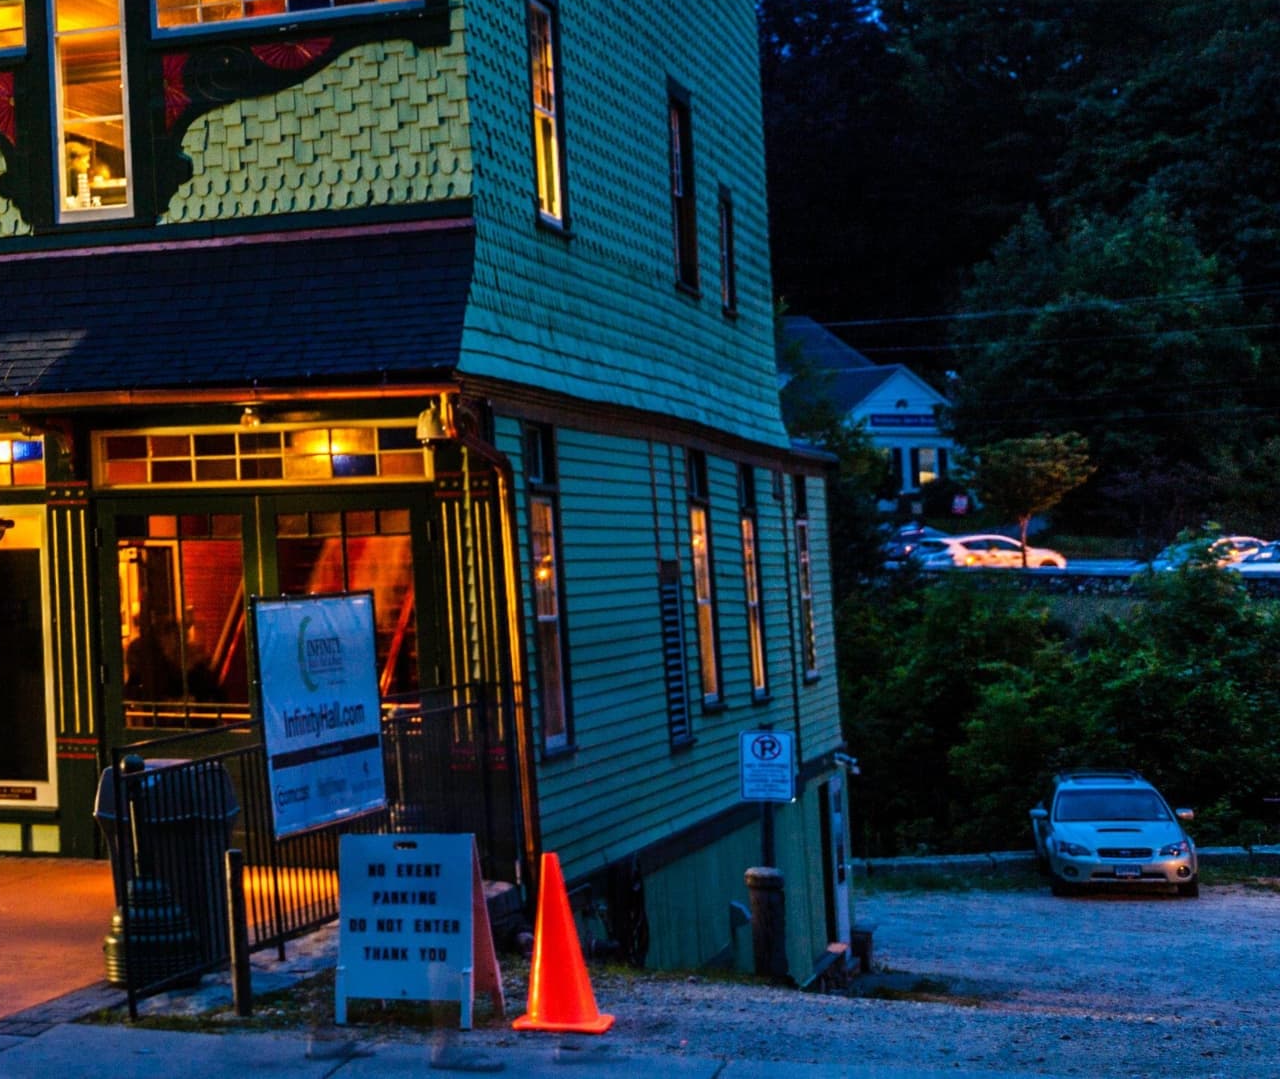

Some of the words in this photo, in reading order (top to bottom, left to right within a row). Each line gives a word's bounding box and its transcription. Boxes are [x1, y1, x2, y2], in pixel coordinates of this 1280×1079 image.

[283, 700, 365, 739] InfinityHall.com
[368, 863, 385, 878] NO
[396, 863, 442, 878] EVENT
[372, 891, 438, 905] PARKING
[349, 918, 367, 932] DO
[377, 919, 403, 933] NOT
[414, 920, 460, 934] ENTER
[364, 947, 408, 961] THANK
[419, 948, 447, 961] YOU
